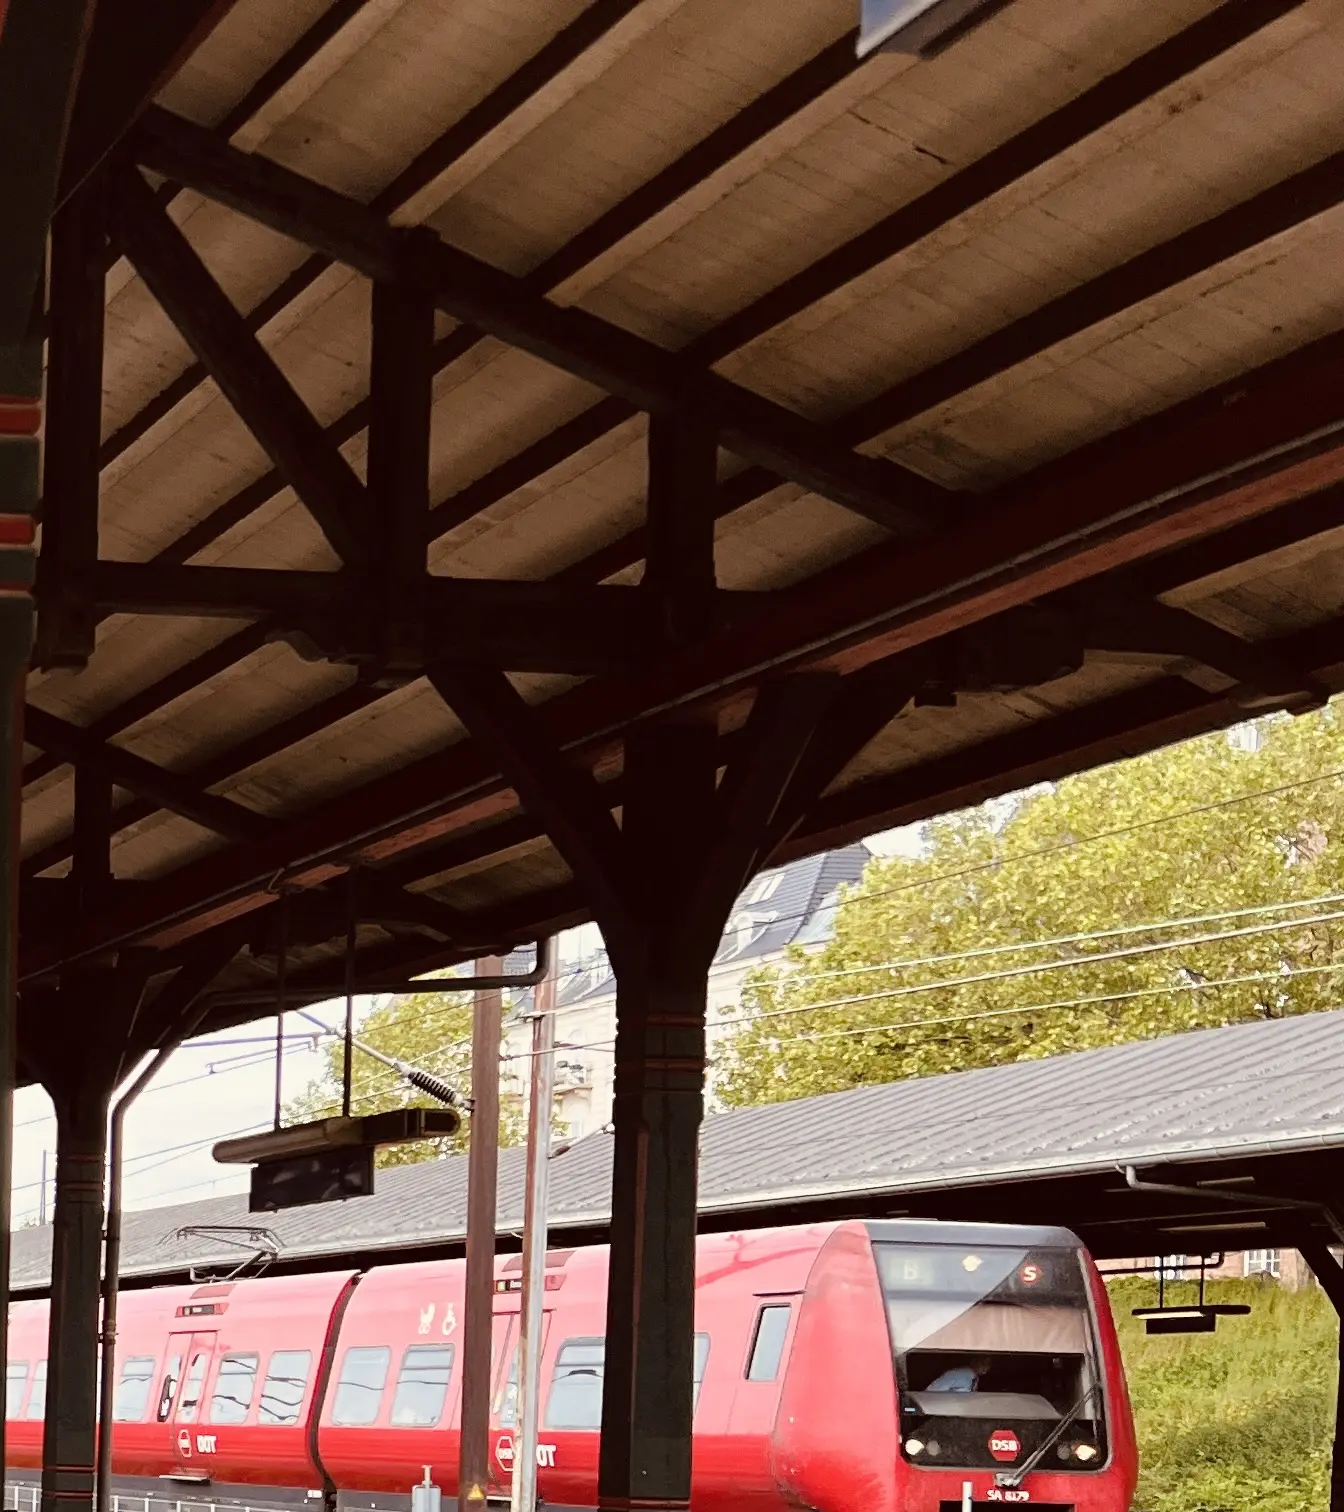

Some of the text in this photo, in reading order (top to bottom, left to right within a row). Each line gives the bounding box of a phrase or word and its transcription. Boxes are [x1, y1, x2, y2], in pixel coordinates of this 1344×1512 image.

[1023, 1266, 1037, 1282] S
[991, 1439, 1018, 1452] DSB
[536, 1444, 557, 1467] OT
[986, 1489, 1003, 1501] SA
